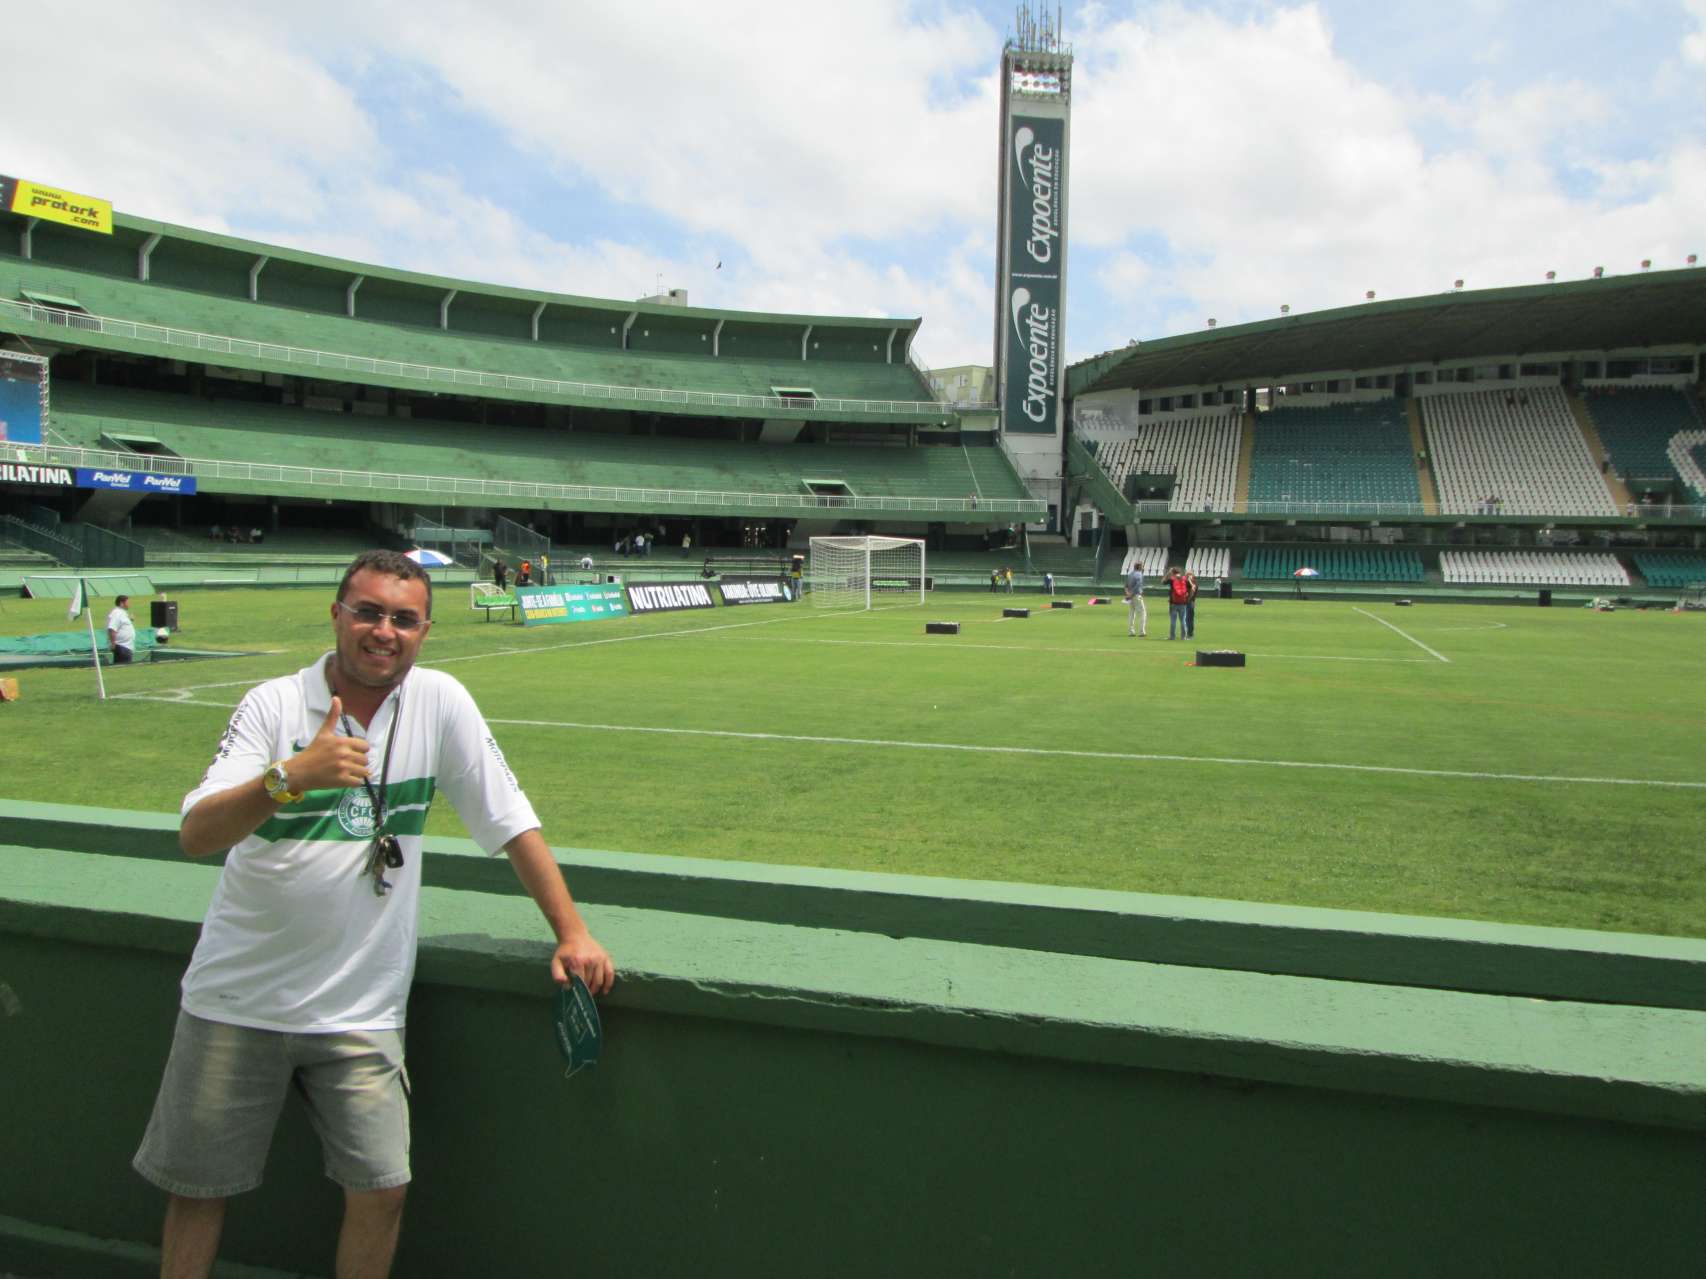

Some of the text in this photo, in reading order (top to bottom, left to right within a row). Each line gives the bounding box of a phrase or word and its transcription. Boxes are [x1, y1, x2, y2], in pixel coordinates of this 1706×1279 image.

[1027, 143, 1059, 263] Expoente
[1022, 303, 1056, 423] Expoente
[0, 464, 72, 485] ILATINA
[628, 585, 712, 610] NUTRILATINA
